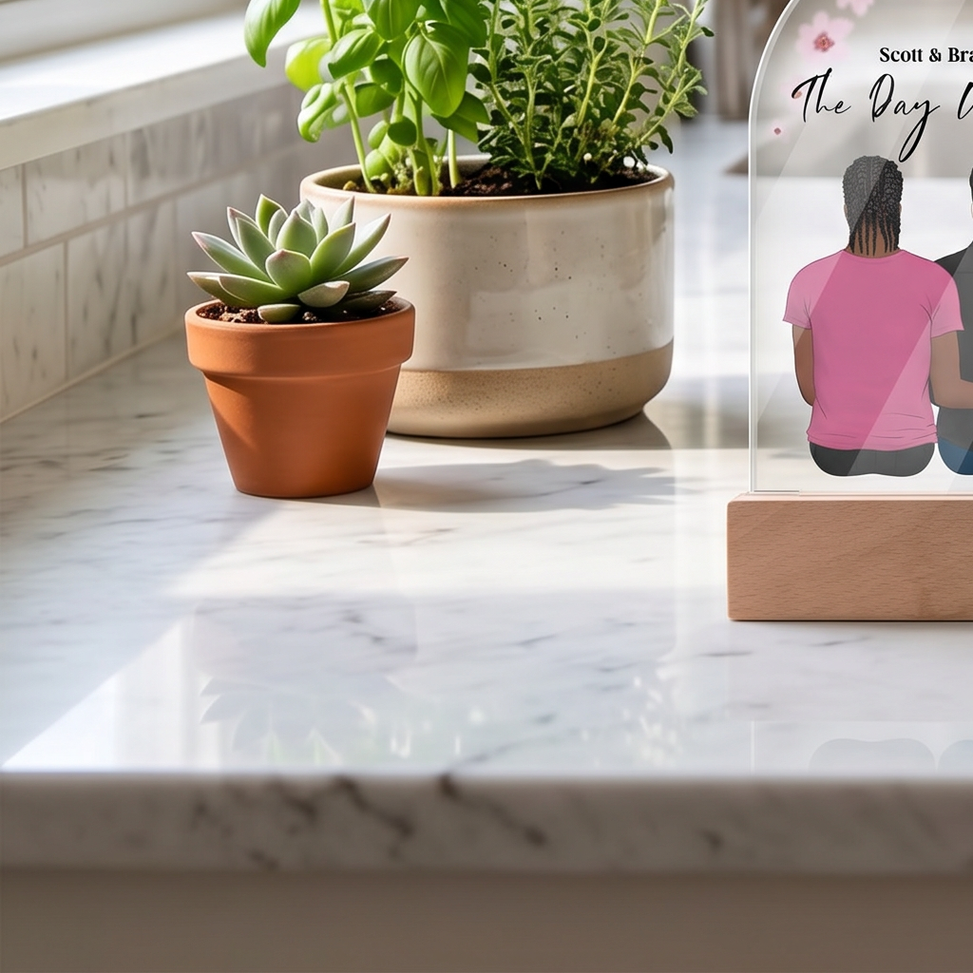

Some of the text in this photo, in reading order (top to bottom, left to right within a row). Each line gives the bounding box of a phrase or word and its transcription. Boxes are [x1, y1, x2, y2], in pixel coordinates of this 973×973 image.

[879, 47, 923, 63] Scott
[928, 48, 942, 63] &
[791, 67, 851, 122] The
[869, 73, 941, 164] Day
